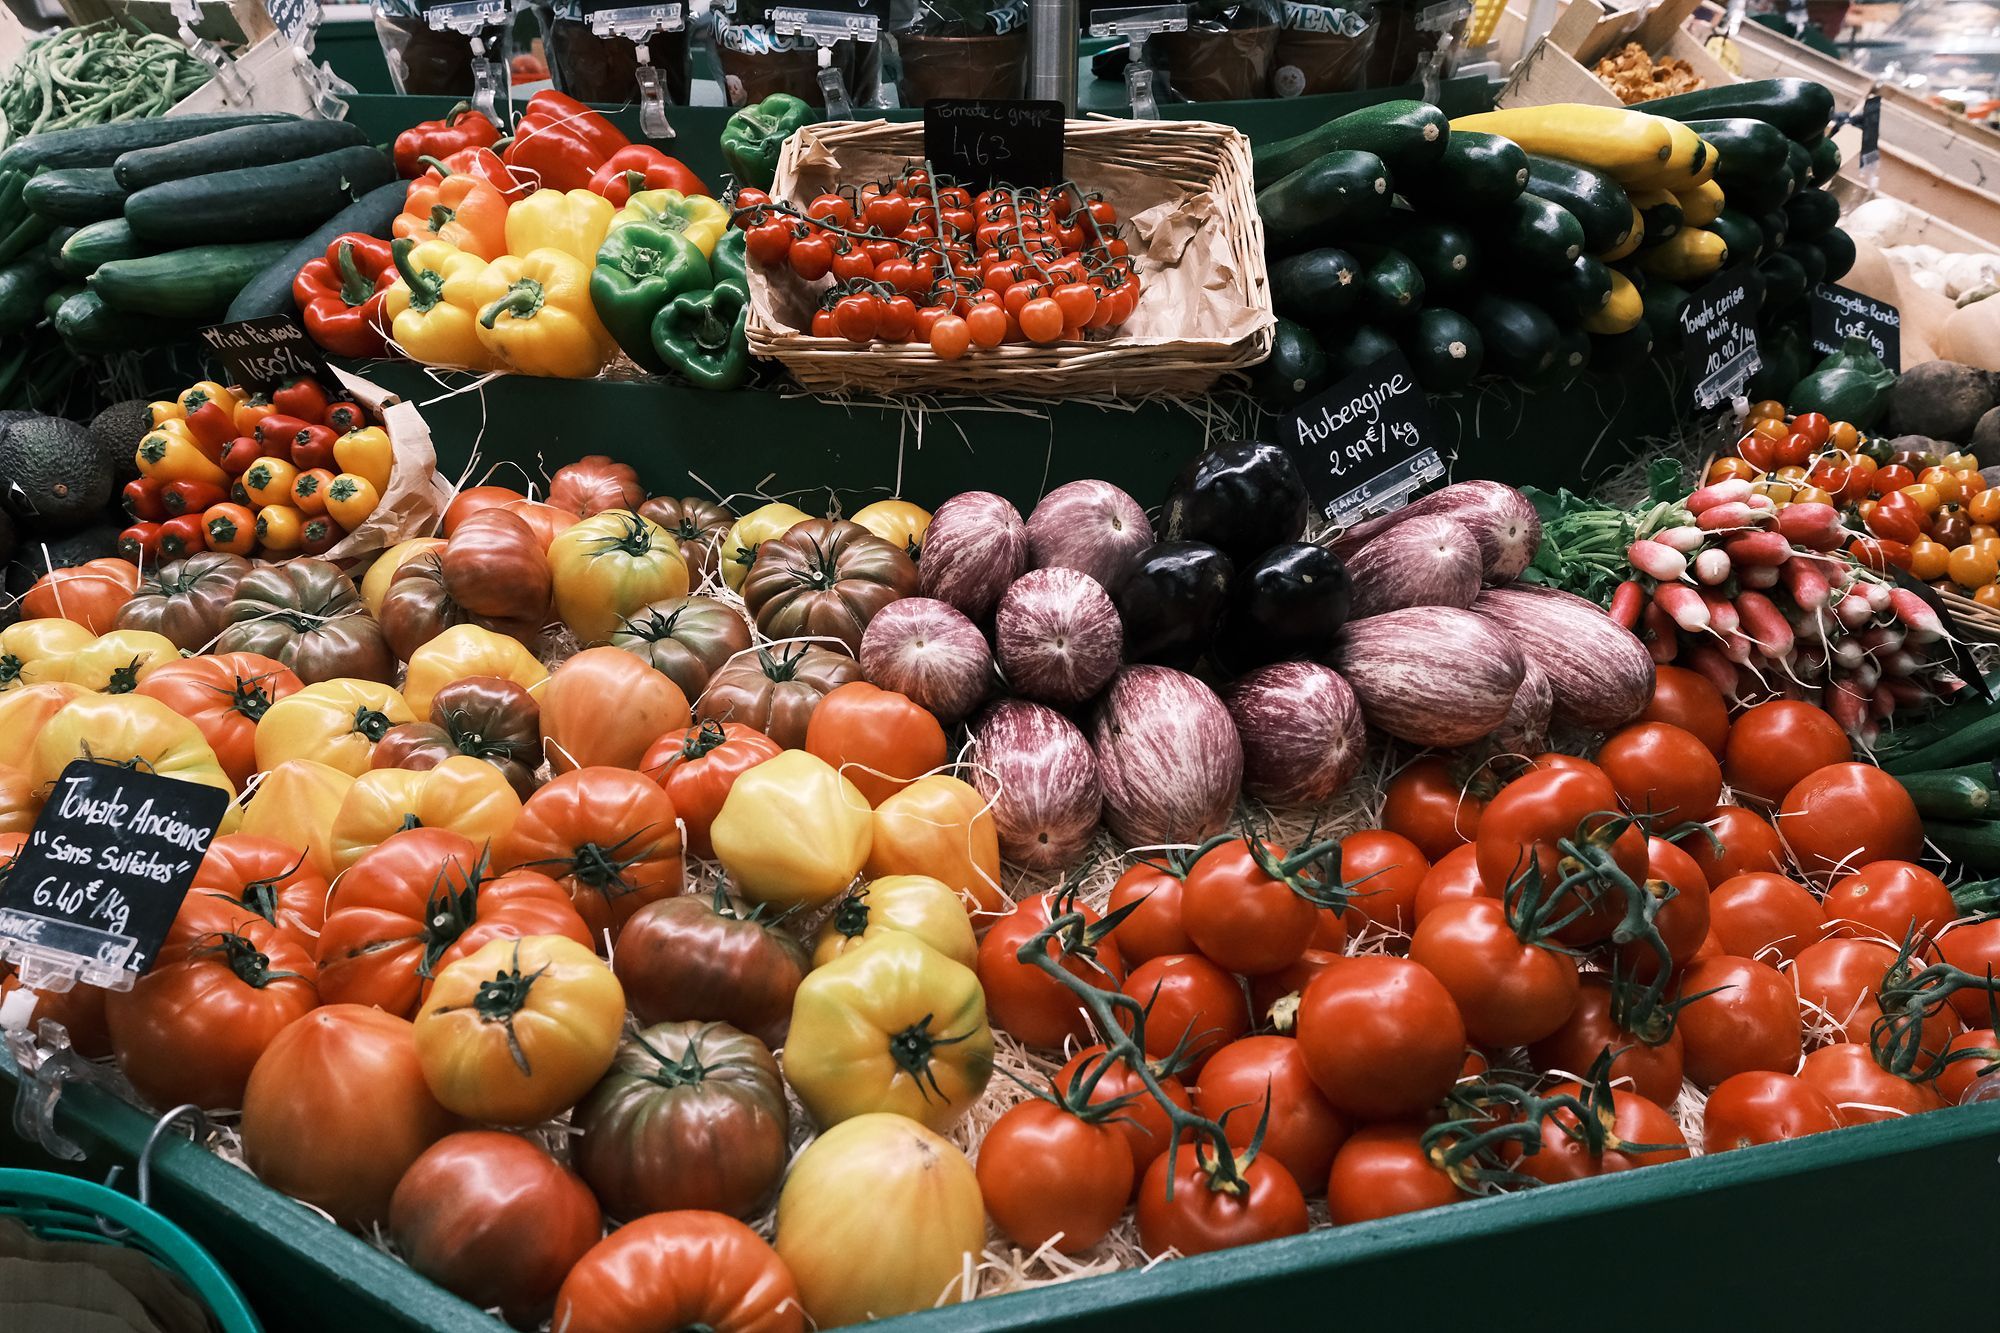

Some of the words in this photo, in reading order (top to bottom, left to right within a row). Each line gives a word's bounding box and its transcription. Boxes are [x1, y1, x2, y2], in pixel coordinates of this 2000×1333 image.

[1680, 300, 1715, 334] Tomate
[1706, 316, 1730, 345] Multi
[202, 327, 250, 349] Mini
[1296, 373, 1413, 446] Aubergine
[1324, 486, 1372, 520] FRANCE
[1409, 456, 1431, 473] CAT
[58, 776, 129, 825] Tomate
